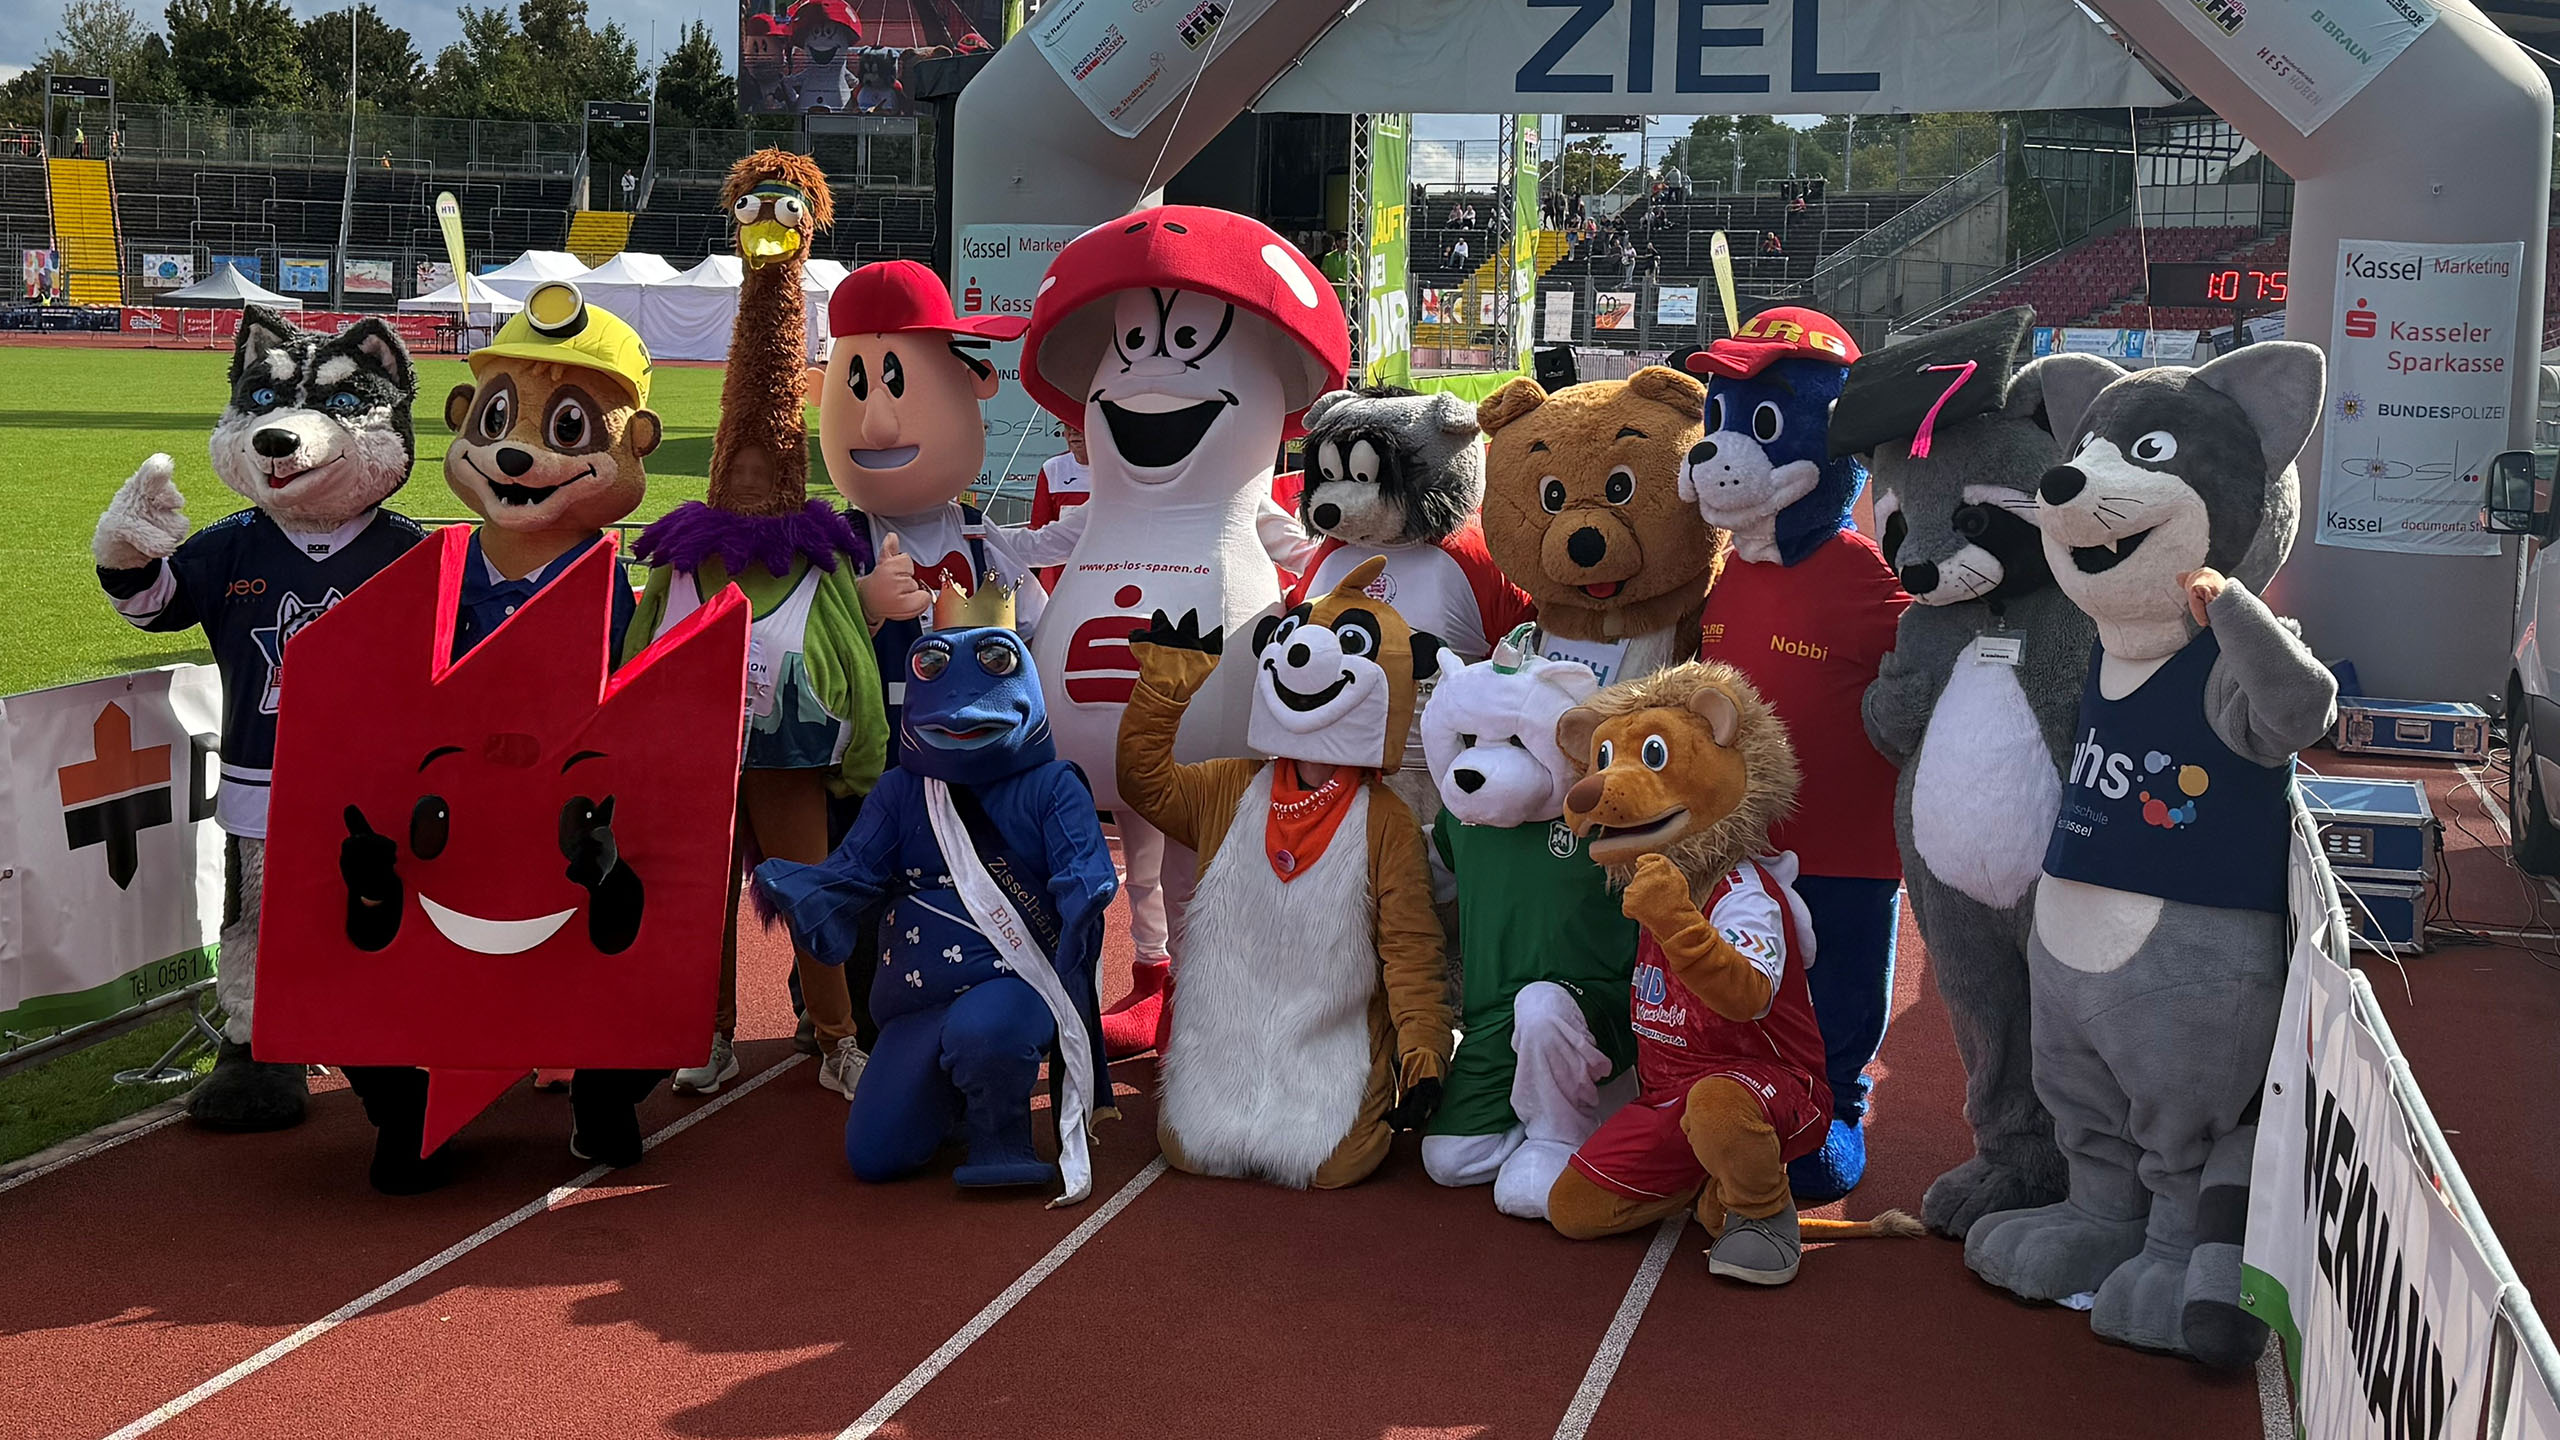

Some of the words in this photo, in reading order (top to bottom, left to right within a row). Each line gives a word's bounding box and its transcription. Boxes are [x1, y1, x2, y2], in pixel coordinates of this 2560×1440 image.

[1180, 2, 1225, 46] FFH
[1515, 0, 1881, 93] ZIEL
[2256, 46, 2291, 77] HESS
[2433, 258, 2510, 278] Marketing
[990, 294, 1032, 312] Kass
[1738, 316, 1847, 357] LRG
[2390, 320, 2492, 343] Kasseler
[2387, 350, 2504, 375] Sparkasse
[2377, 403, 2505, 420] BUNDESPOLIZEI
[2327, 511, 2382, 533] Kassel
[2401, 518, 2466, 533] documenta
[1079, 560, 1210, 575] www.ps-los-sparen.de
[1770, 634, 1828, 661] Nobbi
[2069, 727, 2134, 799] vhs
[989, 904, 1023, 952] Elsa
[130, 970, 153, 999] Tel.
[158, 954, 198, 988] 0561
